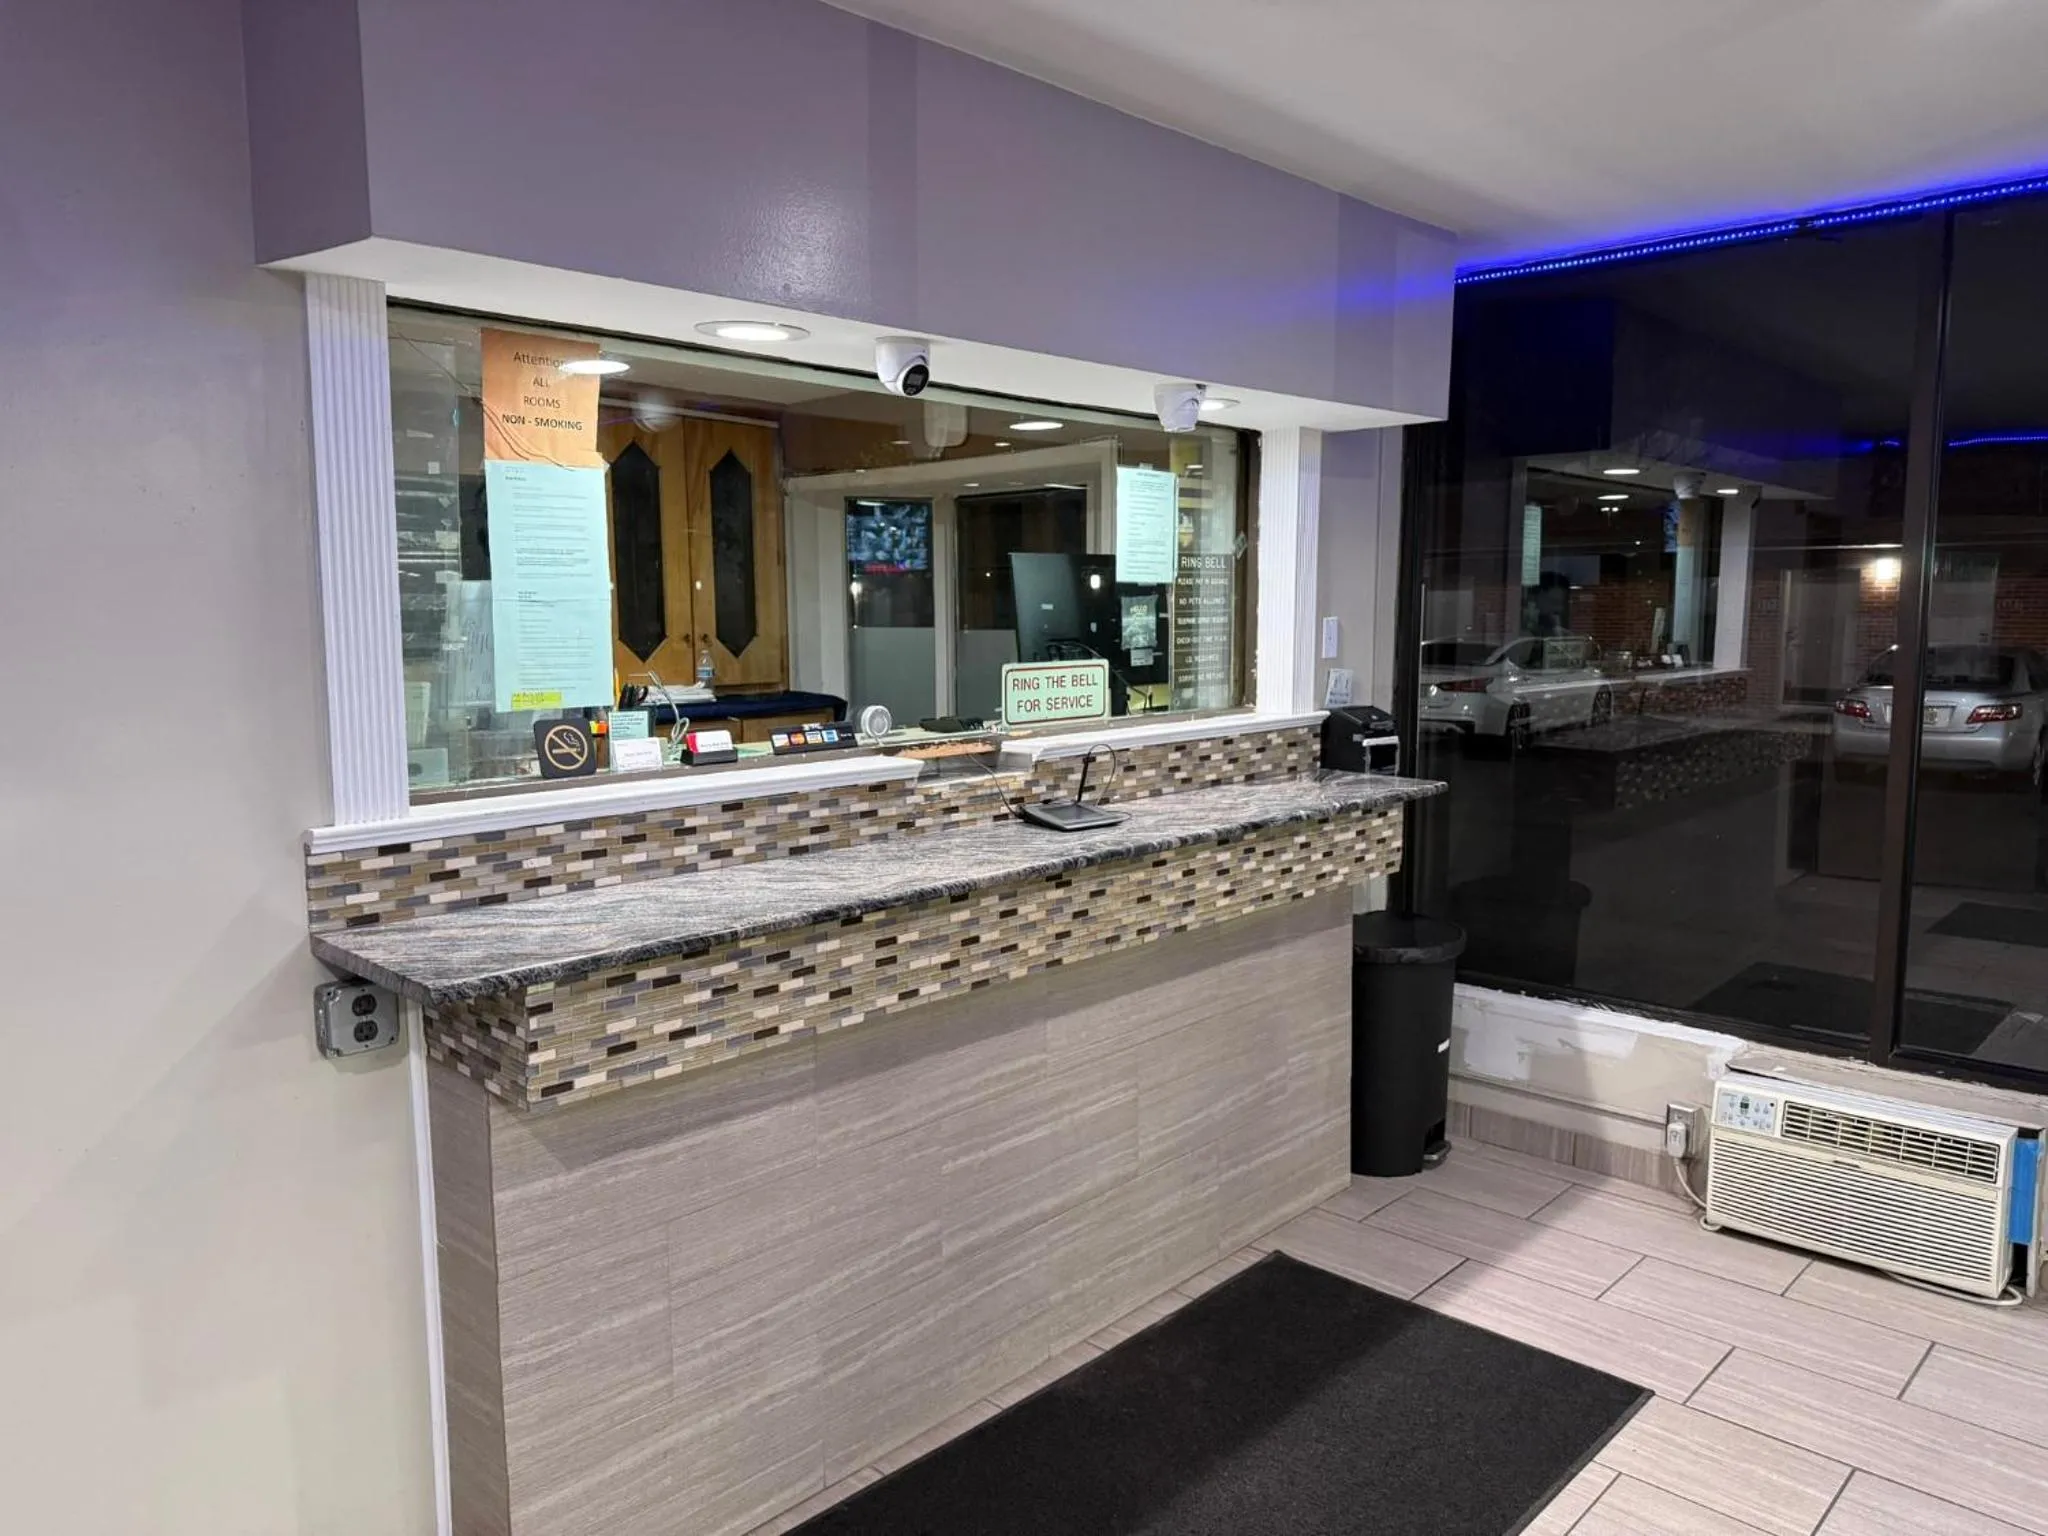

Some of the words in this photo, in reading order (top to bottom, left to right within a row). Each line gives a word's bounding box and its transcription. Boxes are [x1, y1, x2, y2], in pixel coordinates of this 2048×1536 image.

[532, 376, 550, 388] ALL
[523, 395, 561, 409] ROOMS
[502, 413, 526, 425] NON
[535, 417, 583, 431] SMOKING
[1181, 556, 1202, 569] RING
[1204, 556, 1227, 569] BELL
[1012, 677, 1040, 691] RING
[1044, 675, 1068, 689] THE
[1071, 673, 1098, 687] BELL
[1016, 699, 1041, 713] FOR
[1046, 694, 1094, 712] SERVICE
